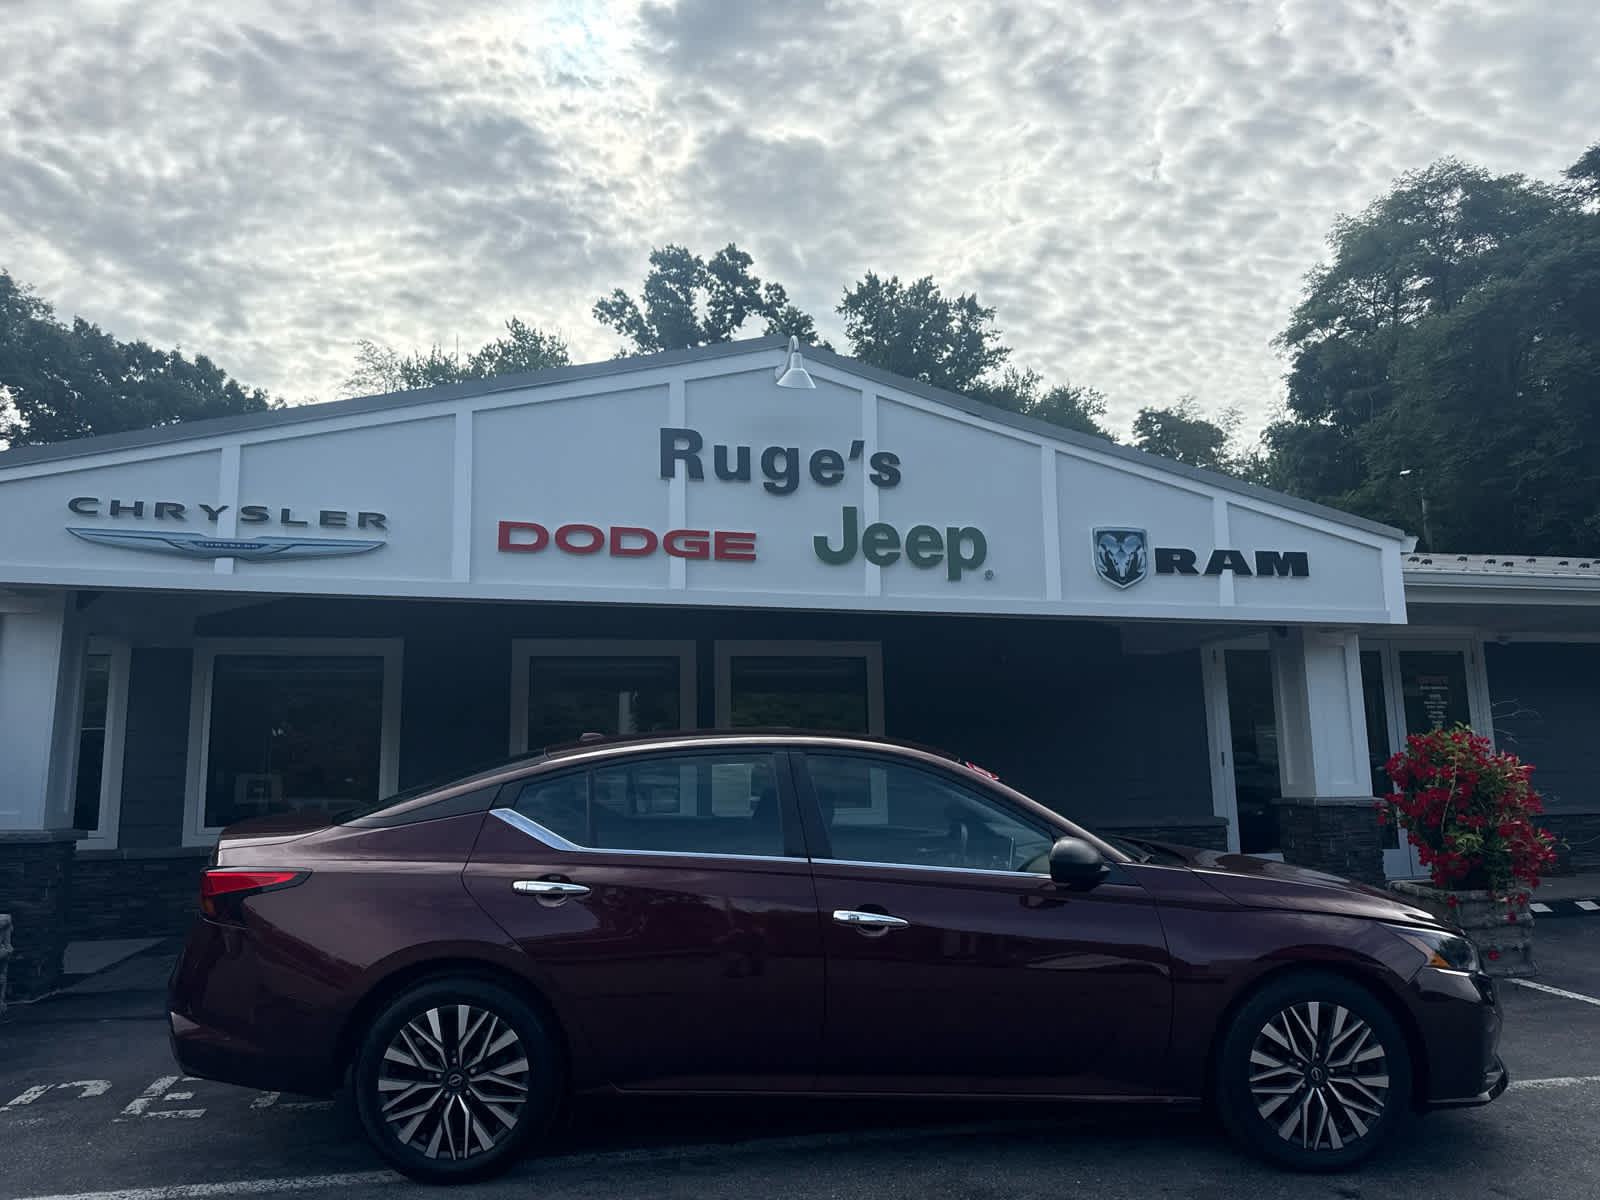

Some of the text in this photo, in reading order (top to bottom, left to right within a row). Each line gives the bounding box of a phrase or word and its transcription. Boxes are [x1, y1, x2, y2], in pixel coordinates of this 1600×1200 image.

[660, 427, 901, 494] Ruge's
[68, 497, 388, 529] CHRYSLER
[498, 520, 756, 560] DODGE
[813, 506, 987, 581] Jeep
[1154, 548, 1309, 576] RAM
